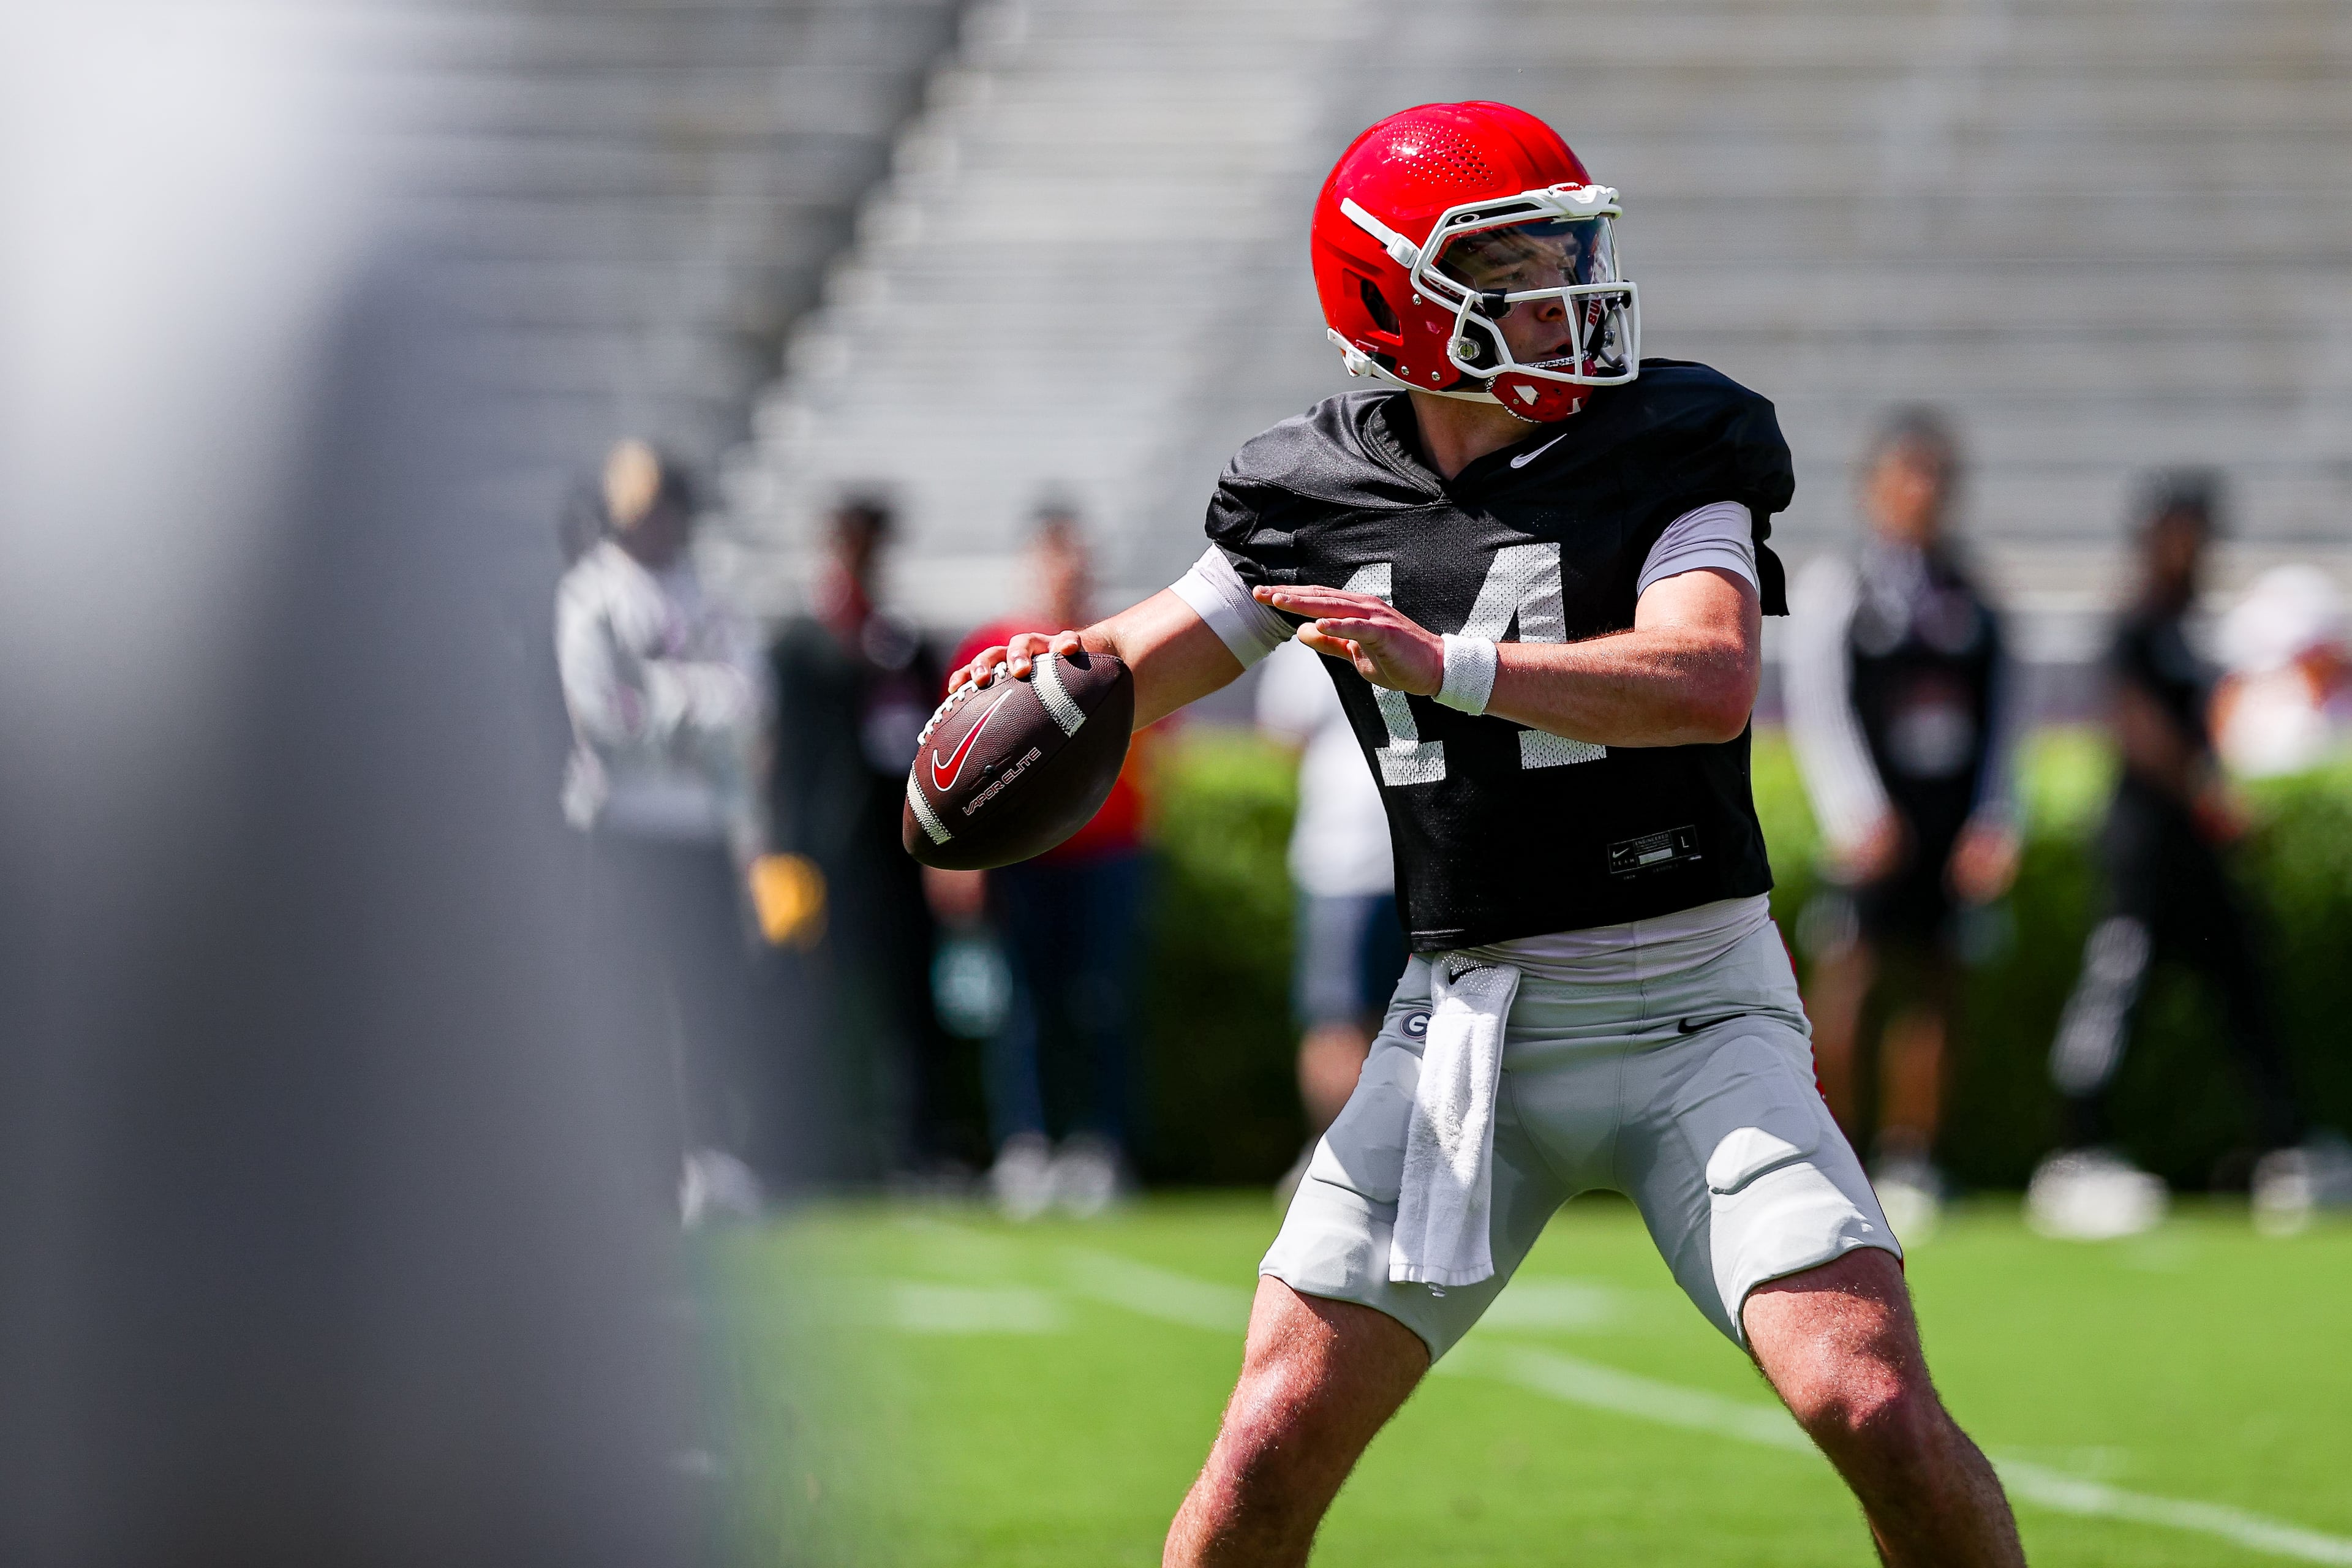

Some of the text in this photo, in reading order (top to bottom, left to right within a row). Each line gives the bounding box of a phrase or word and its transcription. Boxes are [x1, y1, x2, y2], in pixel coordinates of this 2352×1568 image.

[962, 747, 1041, 815] VAPOR ELITE
[1635, 834, 1669, 846] ENGINEERED
[1681, 836, 1689, 848] L
[1401, 1010, 1432, 1039] G
